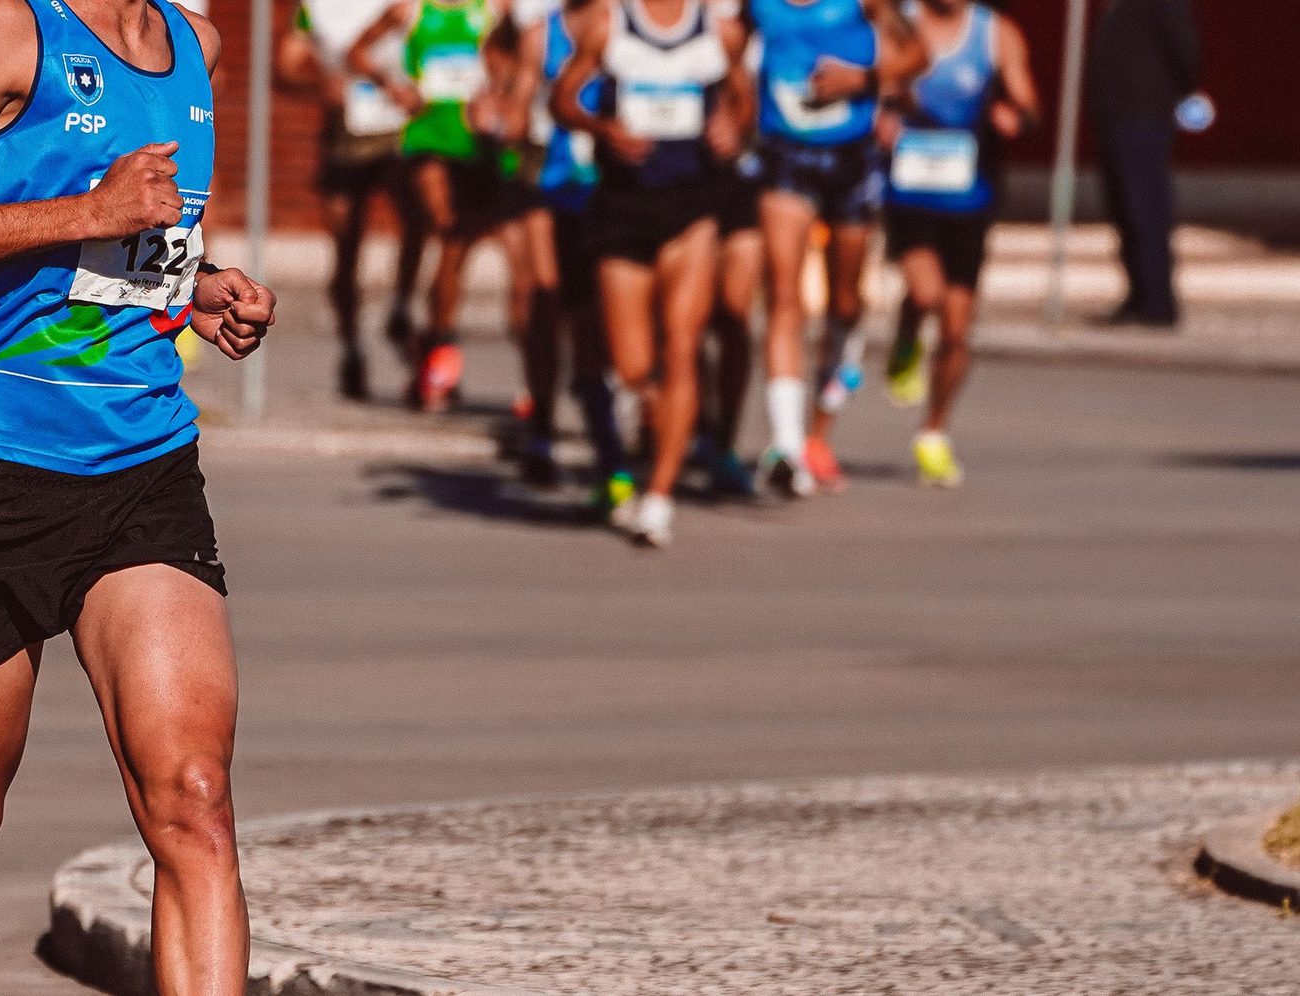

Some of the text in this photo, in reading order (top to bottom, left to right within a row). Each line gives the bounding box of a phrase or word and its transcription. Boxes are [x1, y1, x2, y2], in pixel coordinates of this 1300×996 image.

[65, 112, 106, 134] PSP
[182, 207, 192, 215] DE
[121, 232, 187, 276] 122
